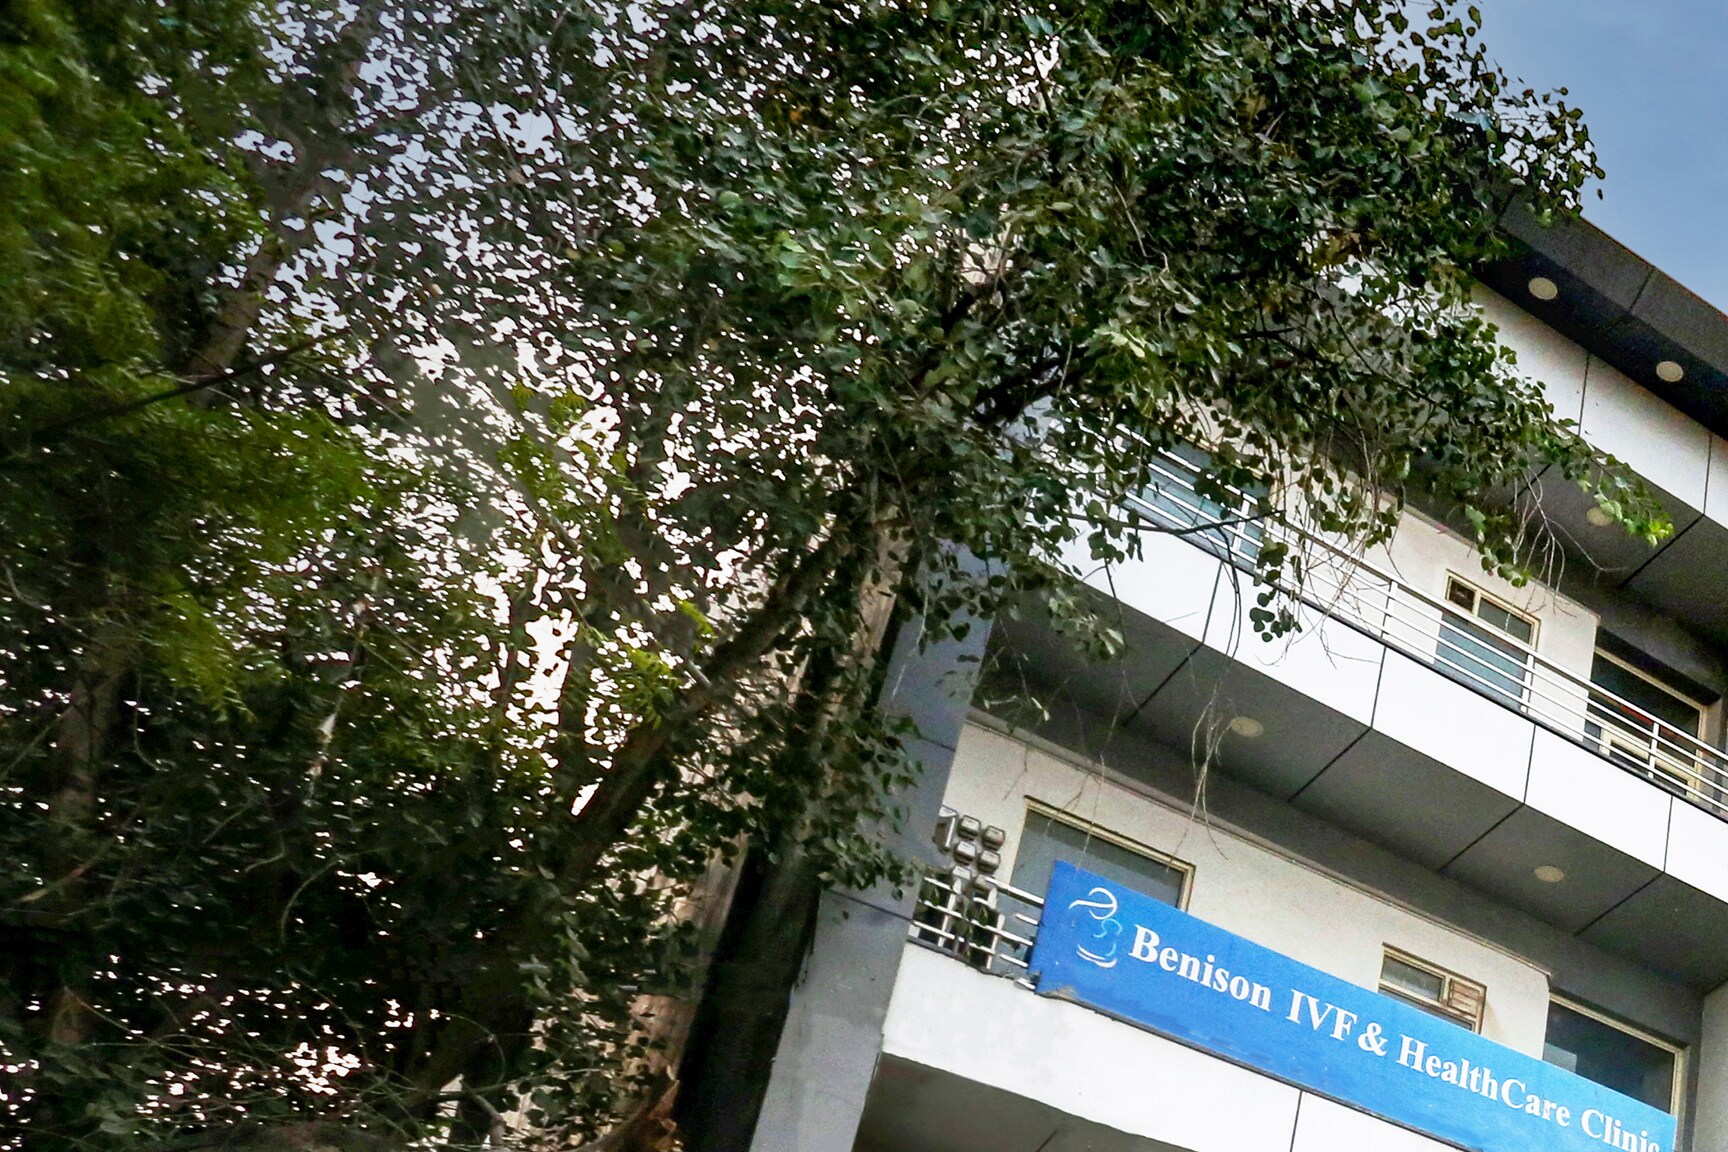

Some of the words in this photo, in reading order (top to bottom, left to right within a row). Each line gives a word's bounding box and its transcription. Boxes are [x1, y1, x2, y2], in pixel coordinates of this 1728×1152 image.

[1129, 923, 1272, 1012] Benison
[1285, 987, 1358, 1044] IVF
[1357, 1023, 1389, 1058] &
[1398, 1033, 1571, 1127] HealthCare
